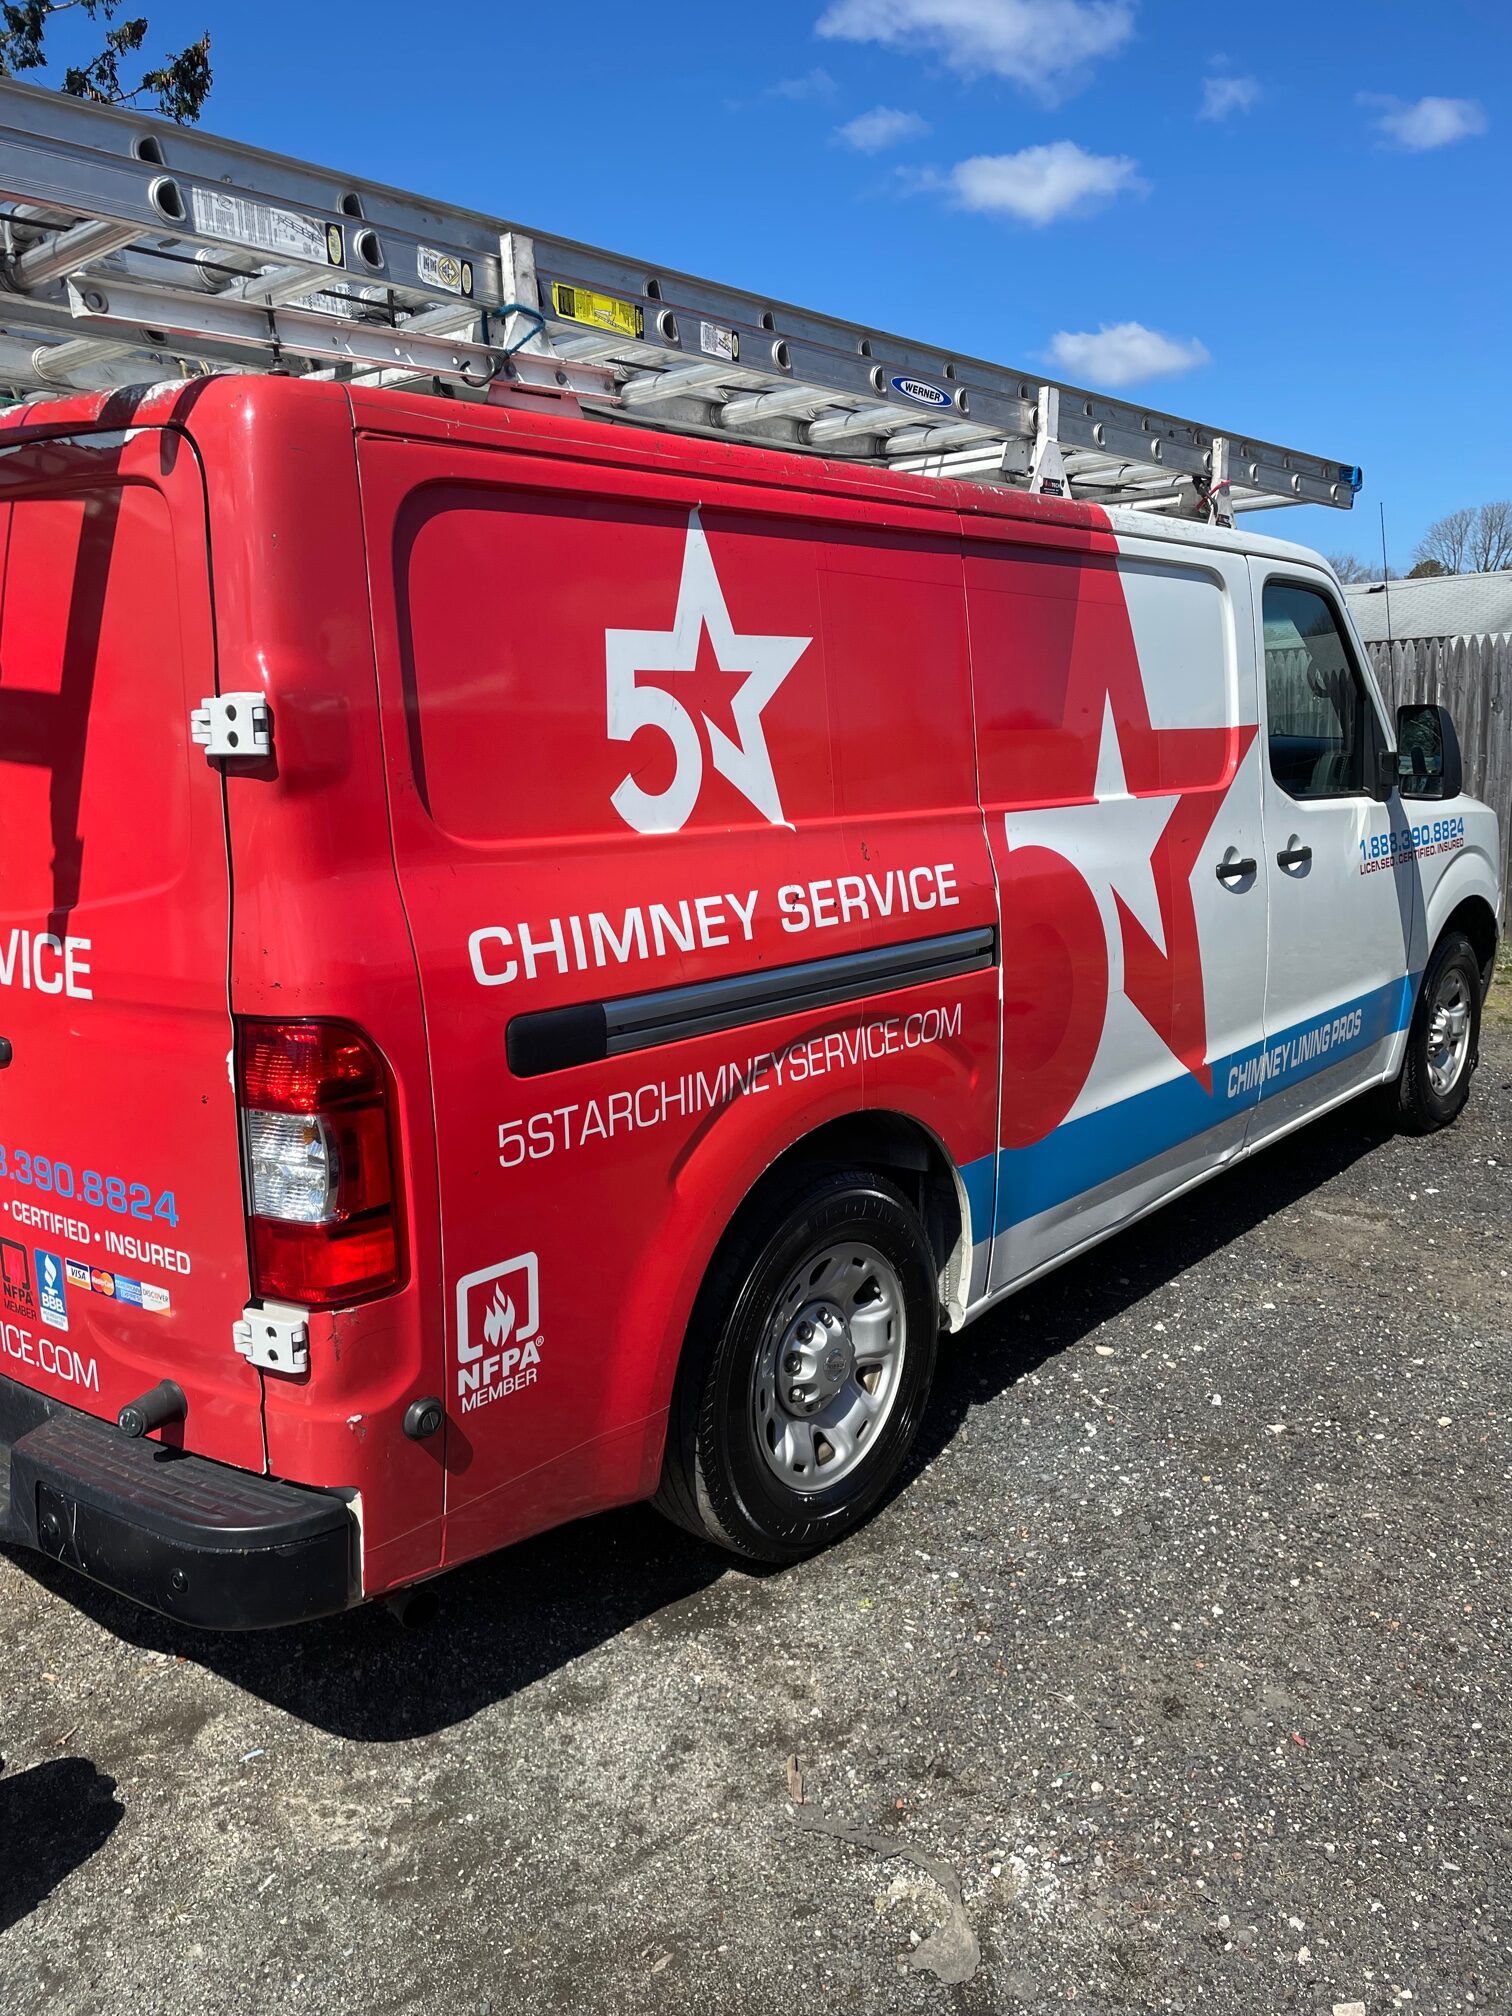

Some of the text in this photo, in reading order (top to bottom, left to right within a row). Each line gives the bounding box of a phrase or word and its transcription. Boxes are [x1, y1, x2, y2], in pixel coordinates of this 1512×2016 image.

[905, 382, 940, 402] WERNER
[1360, 817, 1465, 861] 1.888.390.8824
[1437, 837, 1464, 853] INSURED
[468, 863, 960, 986] CHIMNEY SERVICE
[1227, 1008, 1362, 1098] CHIMNEY LINING PROS
[497, 1002, 963, 1168] 5STARCHIMNEYSERVICE.COM
[12, 1200, 192, 1275] CERTIFIED INSURED
[71, 1267, 87, 1281] VISA
[143, 1288, 169, 1303] DISCOVER
[4, 1298, 37, 1321] MEMBER
[461, 1367, 538, 1414] MEMBER
